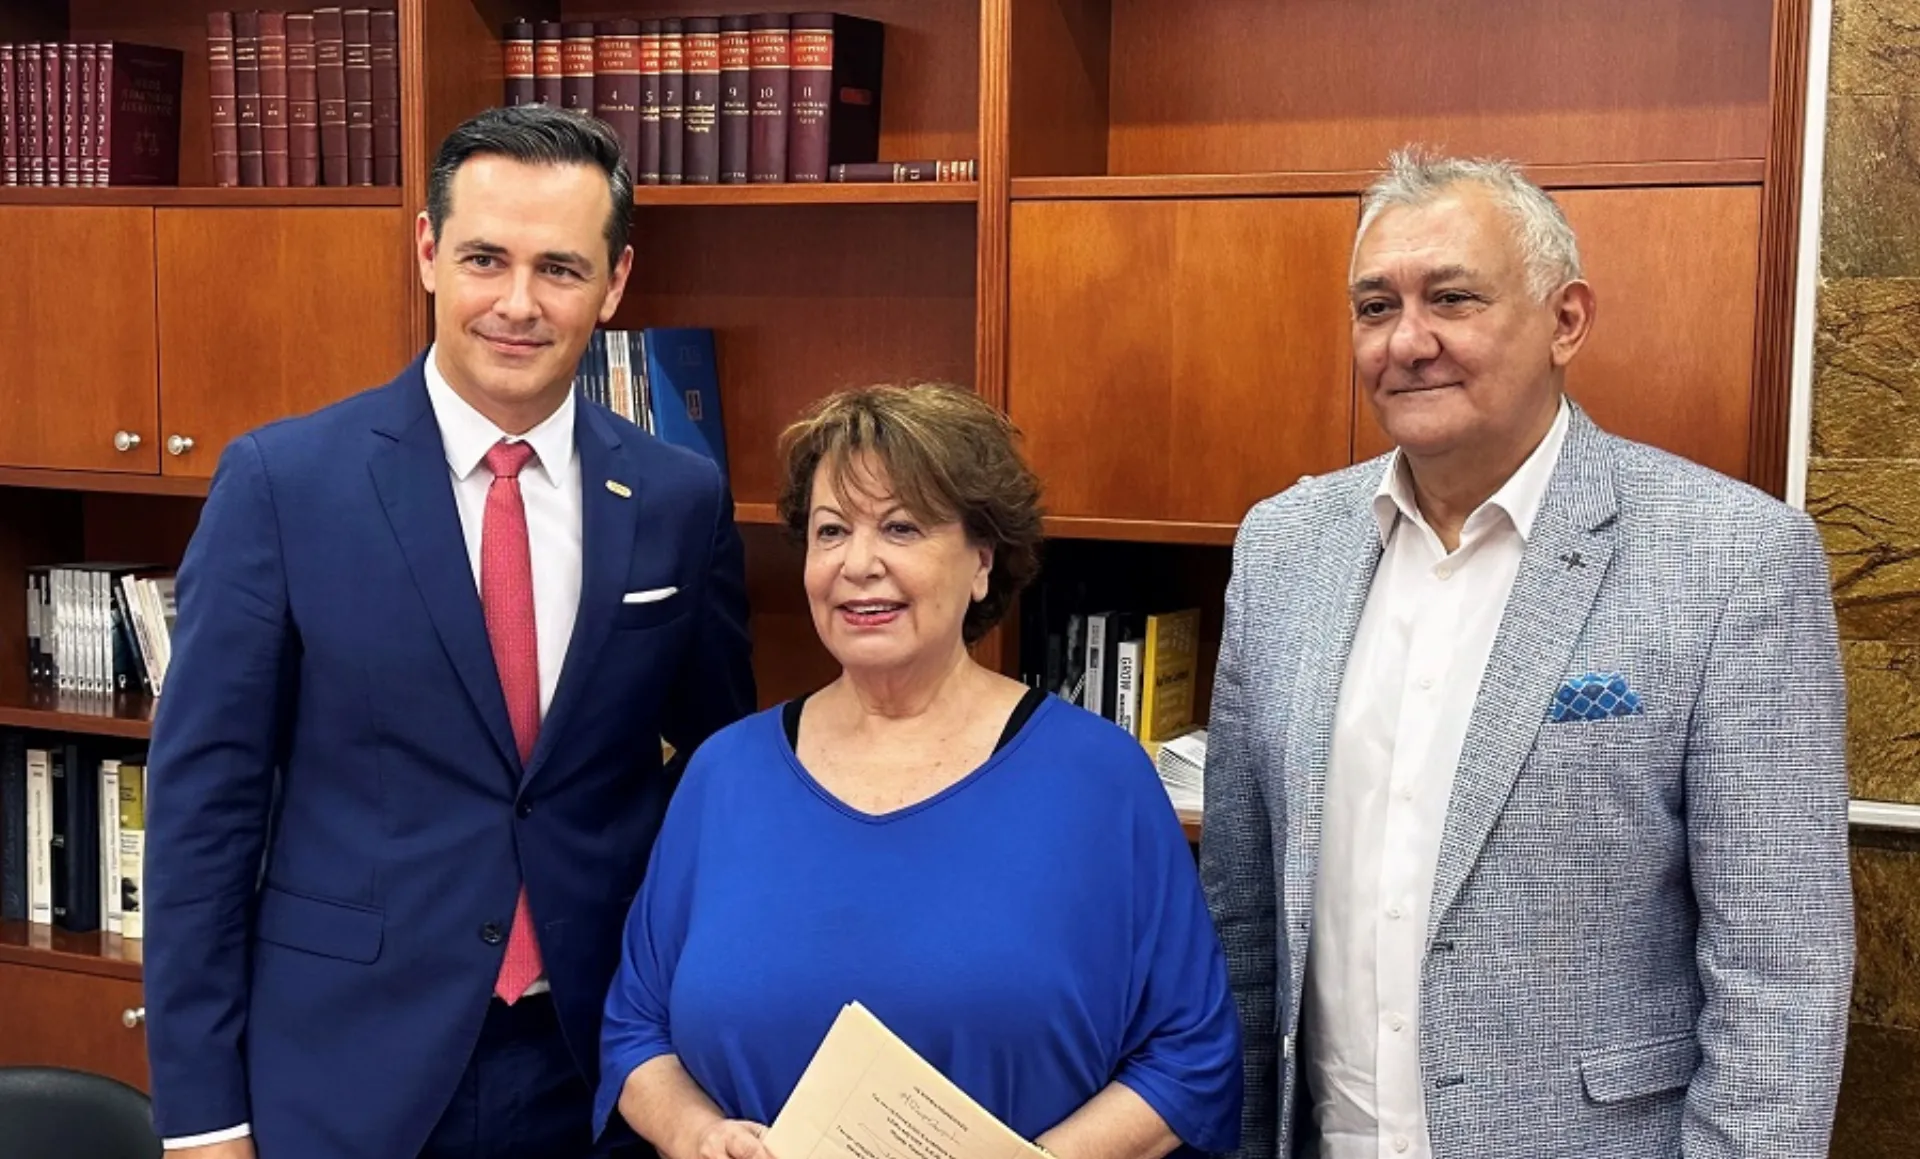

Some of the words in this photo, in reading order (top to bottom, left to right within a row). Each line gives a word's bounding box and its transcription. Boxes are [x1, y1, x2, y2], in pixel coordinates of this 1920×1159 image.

[612, 90, 618, 100] 4
[646, 90, 654, 103] 5
[667, 91, 674, 102] 7
[728, 87, 737, 96] 9
[760, 87, 774, 98] 10
[803, 86, 812, 98] 11
